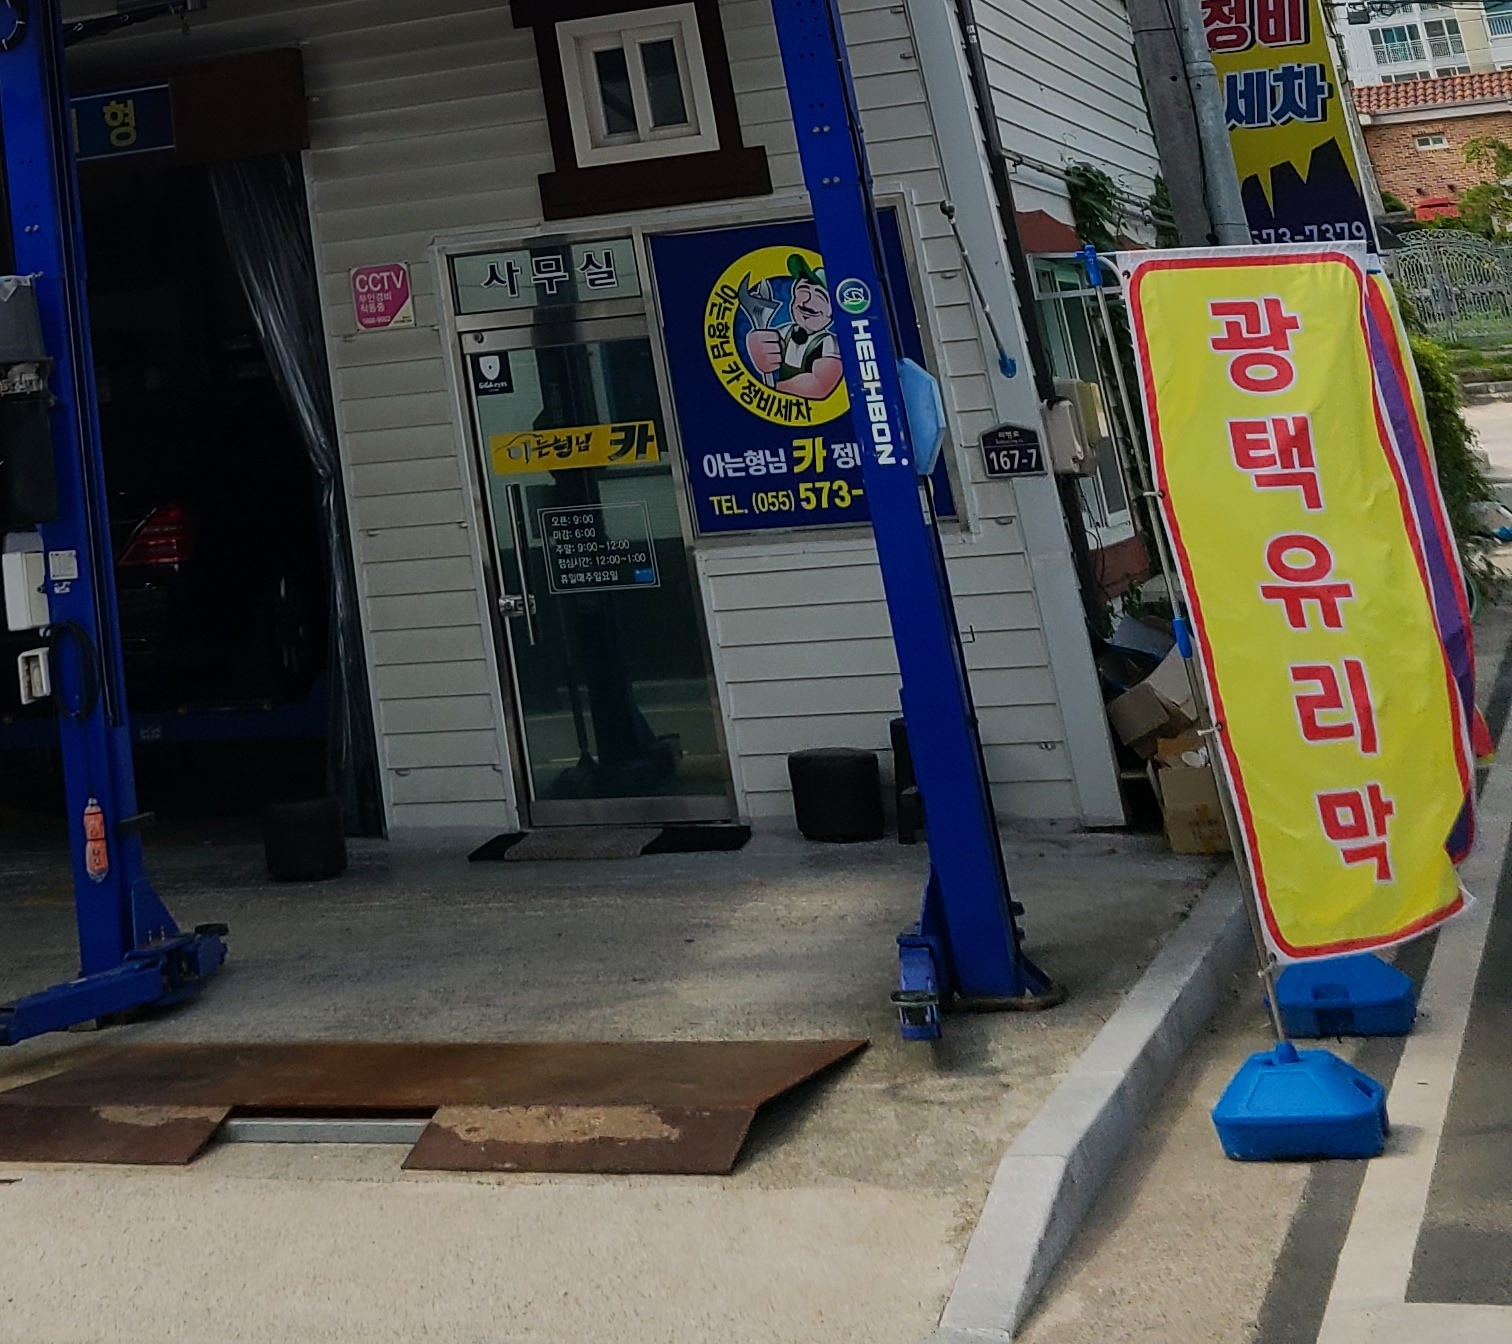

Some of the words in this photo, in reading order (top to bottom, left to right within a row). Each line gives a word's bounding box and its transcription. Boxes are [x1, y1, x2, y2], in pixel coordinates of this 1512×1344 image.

[1224, 63, 1331, 129] 세차
[356, 269, 405, 293] CCTV
[479, 249, 620, 298] 사무실
[707, 283, 739, 360] 아는형님
[721, 360, 741, 386] 카
[851, 318, 897, 466] HESHBON
[739, 378, 813, 423] 정비세차
[607, 423, 655, 462] 카
[702, 447, 787, 478] 아는형님
[792, 436, 827, 473] 카
[989, 448, 1037, 471] 167-7
[572, 514, 594, 525] 9:00
[709, 494, 749, 515] TEL.
[752, 489, 795, 515] (055)
[574, 527, 596, 538] 6:00
